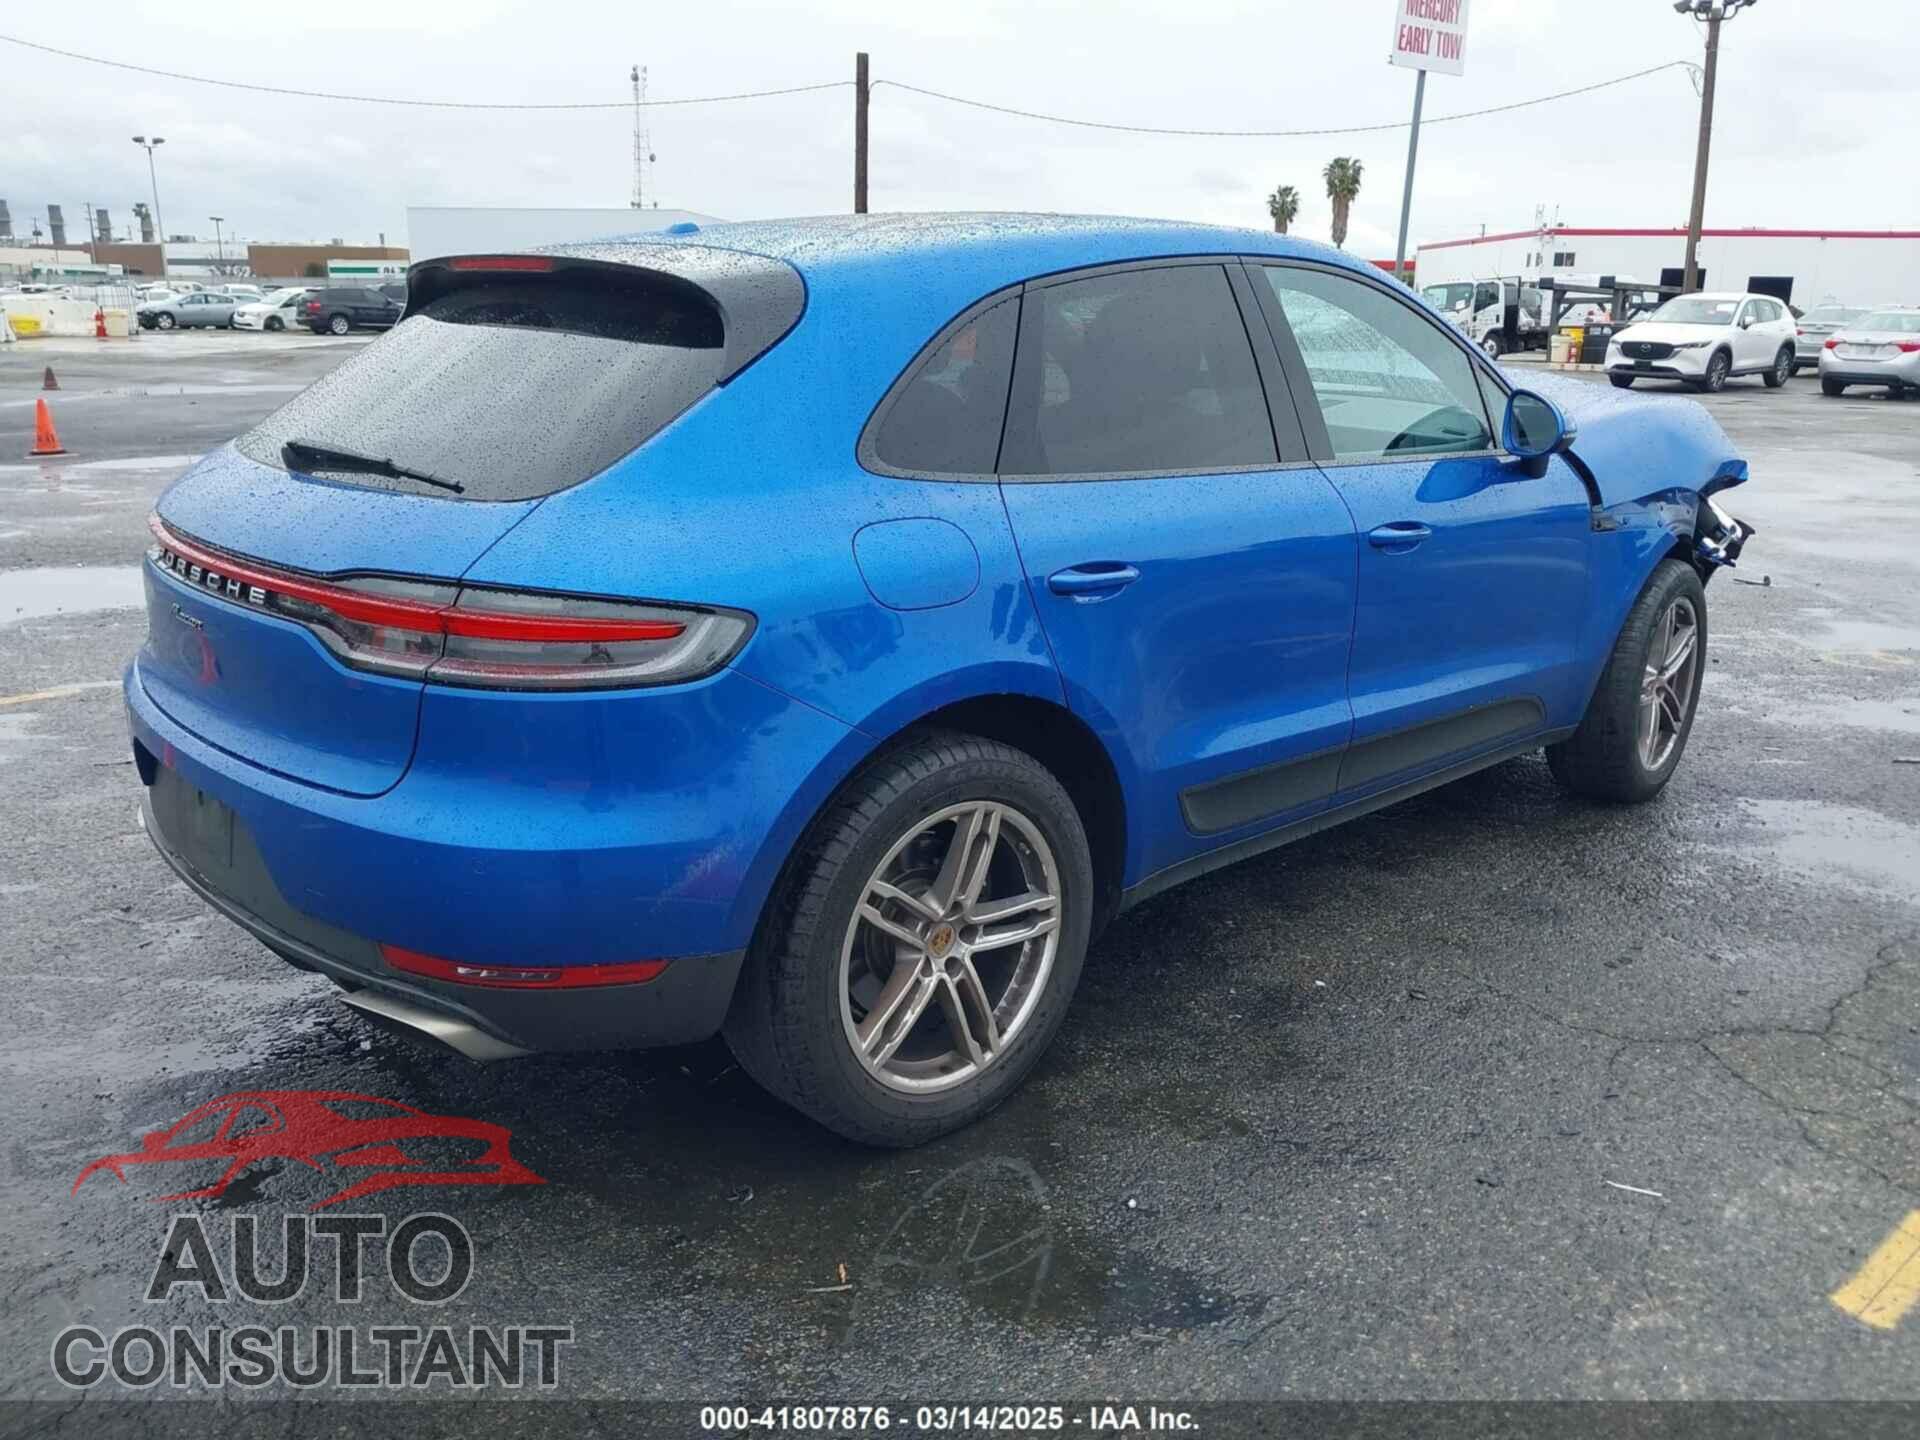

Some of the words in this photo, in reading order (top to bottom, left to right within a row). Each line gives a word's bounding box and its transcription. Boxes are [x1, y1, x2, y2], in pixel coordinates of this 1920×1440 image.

[1405, 0, 1462, 24] MERCURY
[1398, 24, 1433, 56] EARLY
[1436, 30, 1463, 60] TOW
